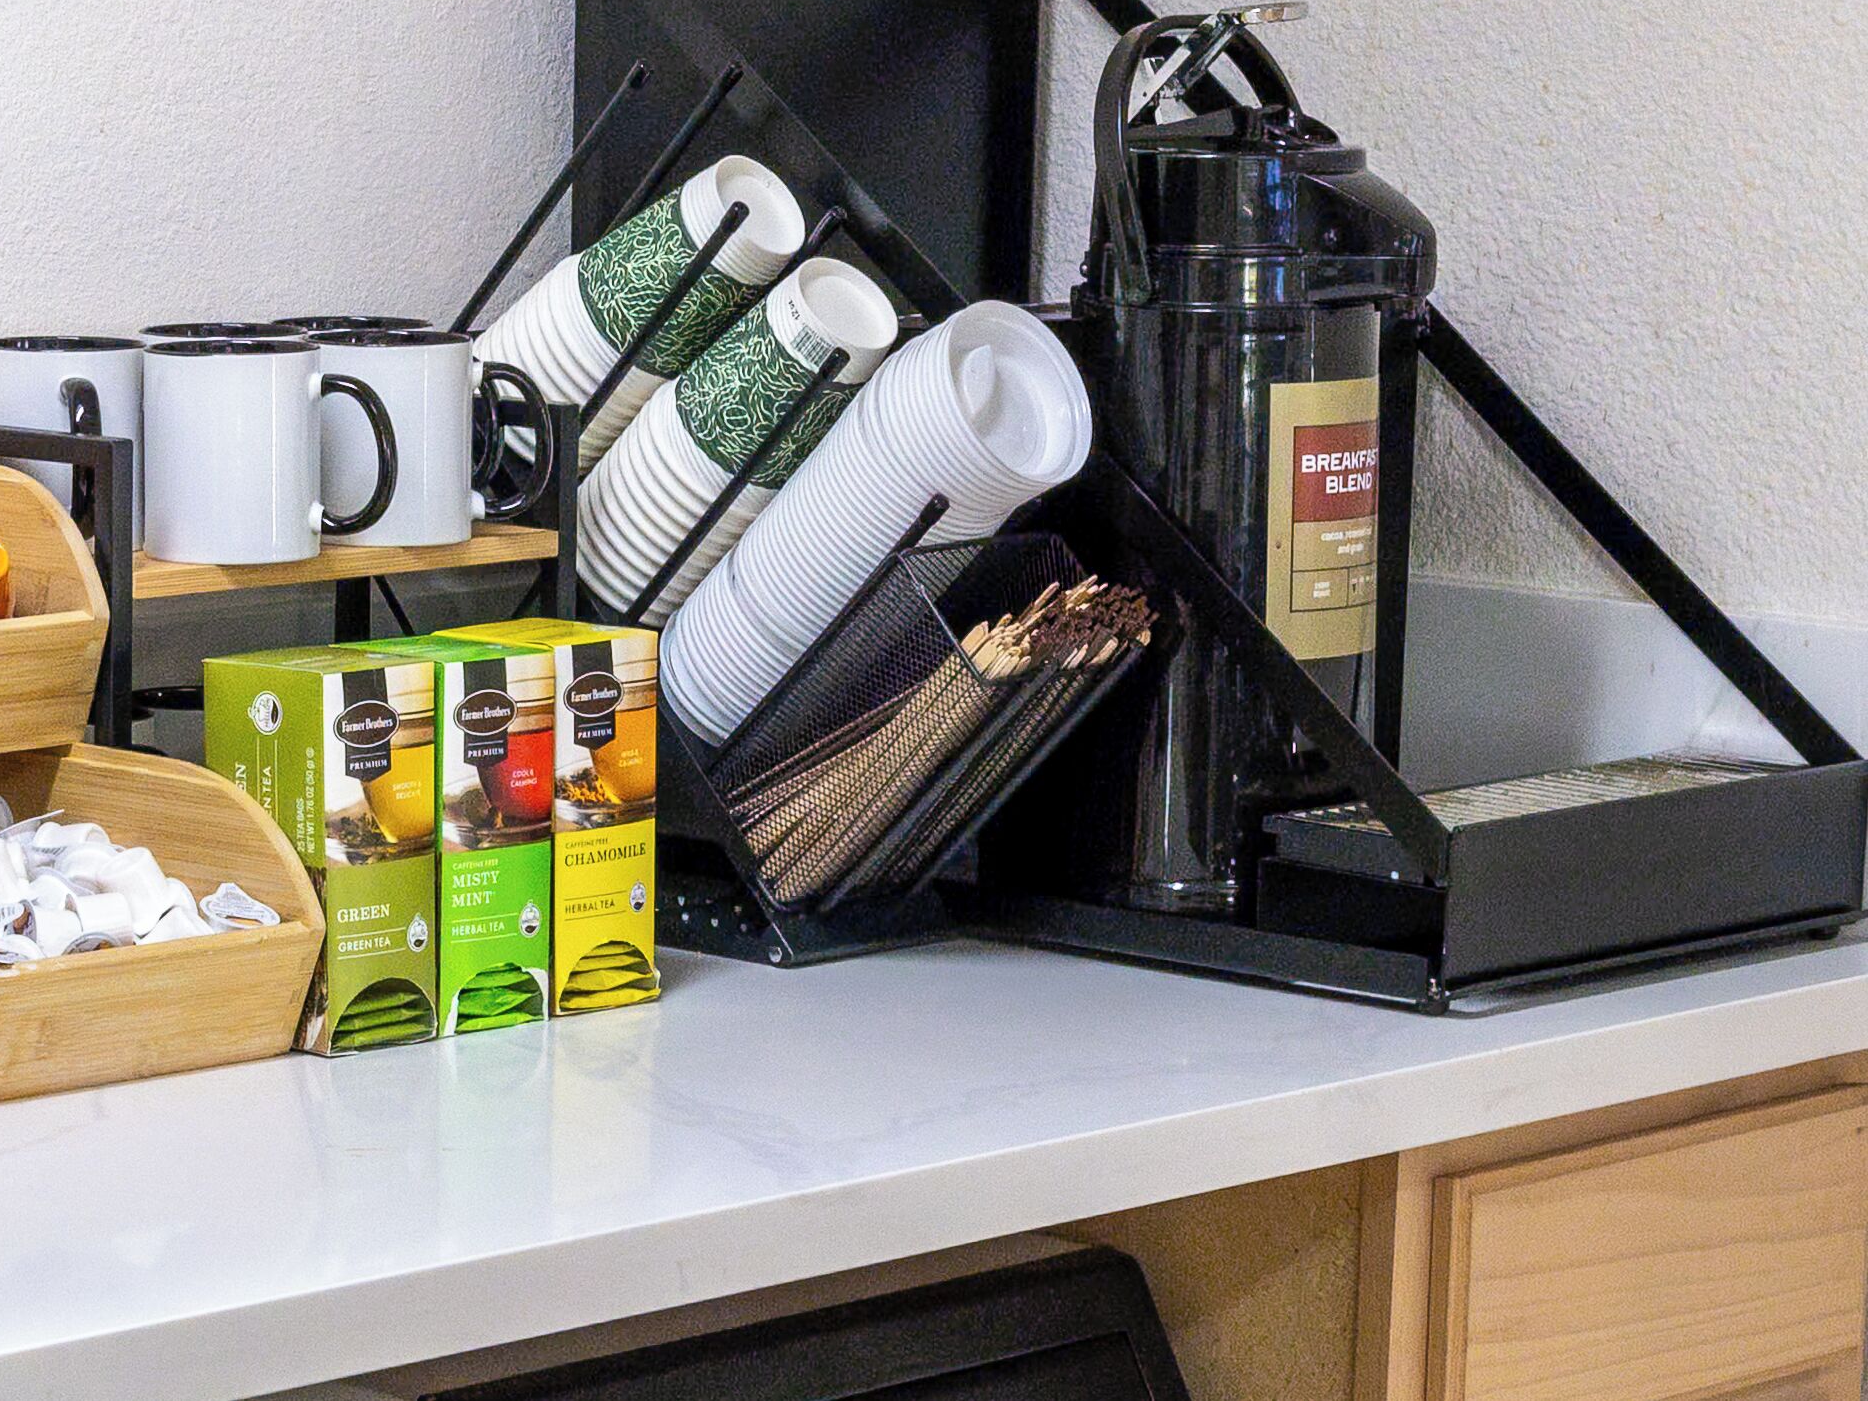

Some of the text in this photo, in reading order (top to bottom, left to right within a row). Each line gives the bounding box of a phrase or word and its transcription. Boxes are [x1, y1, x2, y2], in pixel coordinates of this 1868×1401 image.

[1325, 471, 1373, 494] BLEND
[571, 688, 618, 703] Farmer Brothers
[461, 705, 511, 721] Farmer Brothers
[341, 716, 394, 733] Farmer Brothers
[577, 727, 612, 739] PREMIUM
[467, 747, 504, 758] PREMIUM
[349, 759, 388, 771] PREMIUM
[261, 766, 272, 794] TEA
[295, 797, 305, 822] BAGS
[296, 822, 306, 840] TEA
[306, 821, 315, 835] WT
[306, 836, 316, 853] NET
[565, 838, 609, 849] CAFFEINE FREE
[564, 842, 646, 867] CHAMOMILE
[452, 859, 499, 870] CAFFEINE FREE
[452, 870, 499, 889] MISTY
[337, 903, 391, 923] GREEN
[565, 899, 615, 914] HERBAL TEA
[451, 922, 505, 936] HERBAL TEA
[338, 936, 391, 953] GREEN TEA
